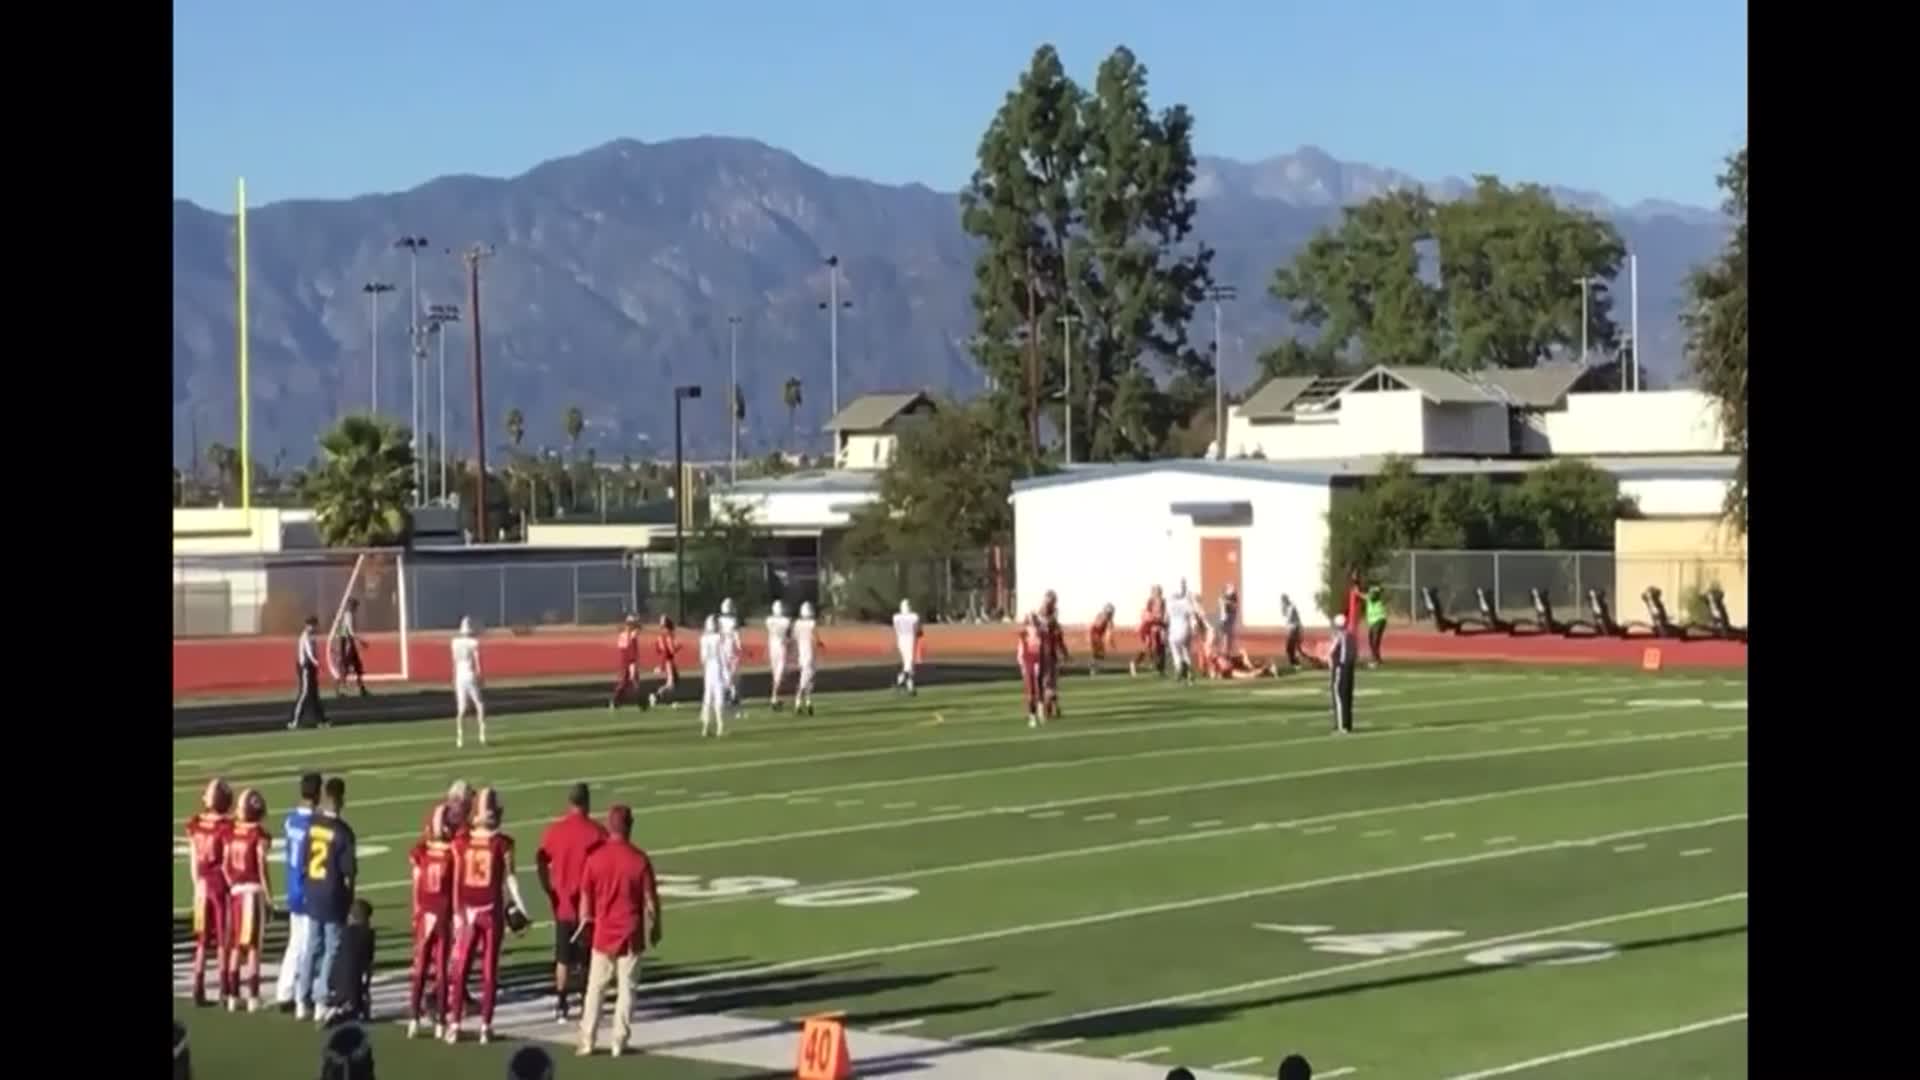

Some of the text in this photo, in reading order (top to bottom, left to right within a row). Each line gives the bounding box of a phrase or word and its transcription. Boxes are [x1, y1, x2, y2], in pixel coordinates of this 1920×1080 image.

[309, 841, 328, 879] 2
[464, 849, 492, 887] 13
[804, 1026, 833, 1073] 40
